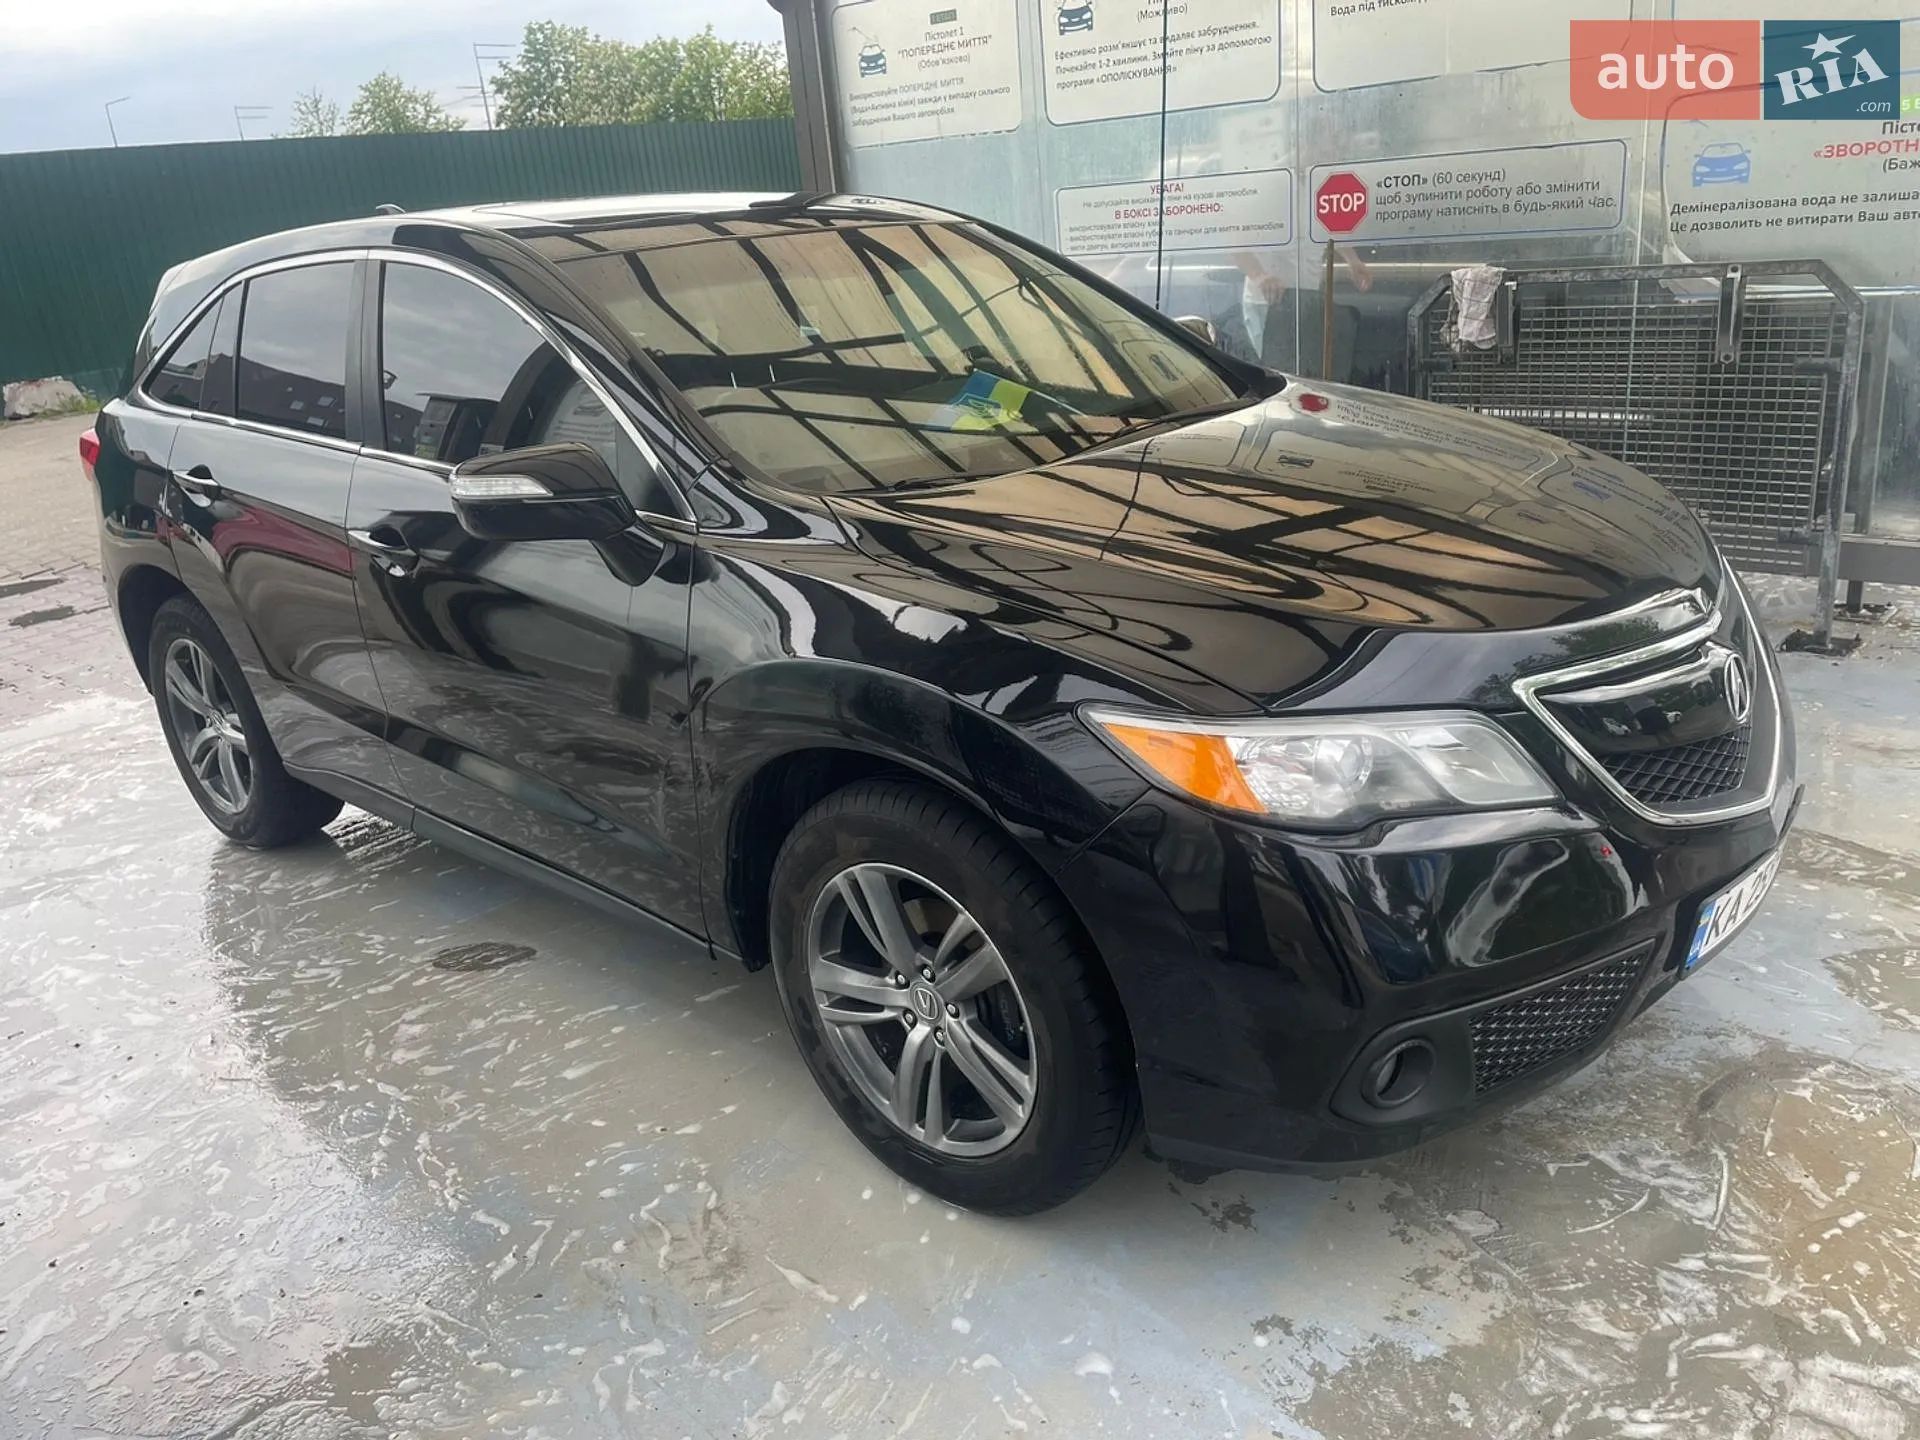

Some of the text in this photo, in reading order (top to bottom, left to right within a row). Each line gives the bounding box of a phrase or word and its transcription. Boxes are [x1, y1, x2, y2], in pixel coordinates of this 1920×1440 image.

[1330, 4, 1356, 17] Вода
[1358, 0, 1376, 12] під
[1376, 168, 1506, 189] «СТОП» (60 секунд)
[1318, 192, 1366, 214] STOP
[1375, 179, 1600, 206] щоб зупинити роботу або змінити
[1375, 195, 1617, 223] програму натисніть в будь-який час.
[1670, 198, 1798, 217] Демінералізована
[1801, 195, 1837, 208] вода
[1841, 194, 1859, 204] не
[1670, 221, 1687, 234] Це
[1690, 218, 1762, 233] дозволить
[1766, 217, 1783, 227] не
[1787, 214, 1854, 226] витирати
[1858, 210, 1889, 223] Ваш
